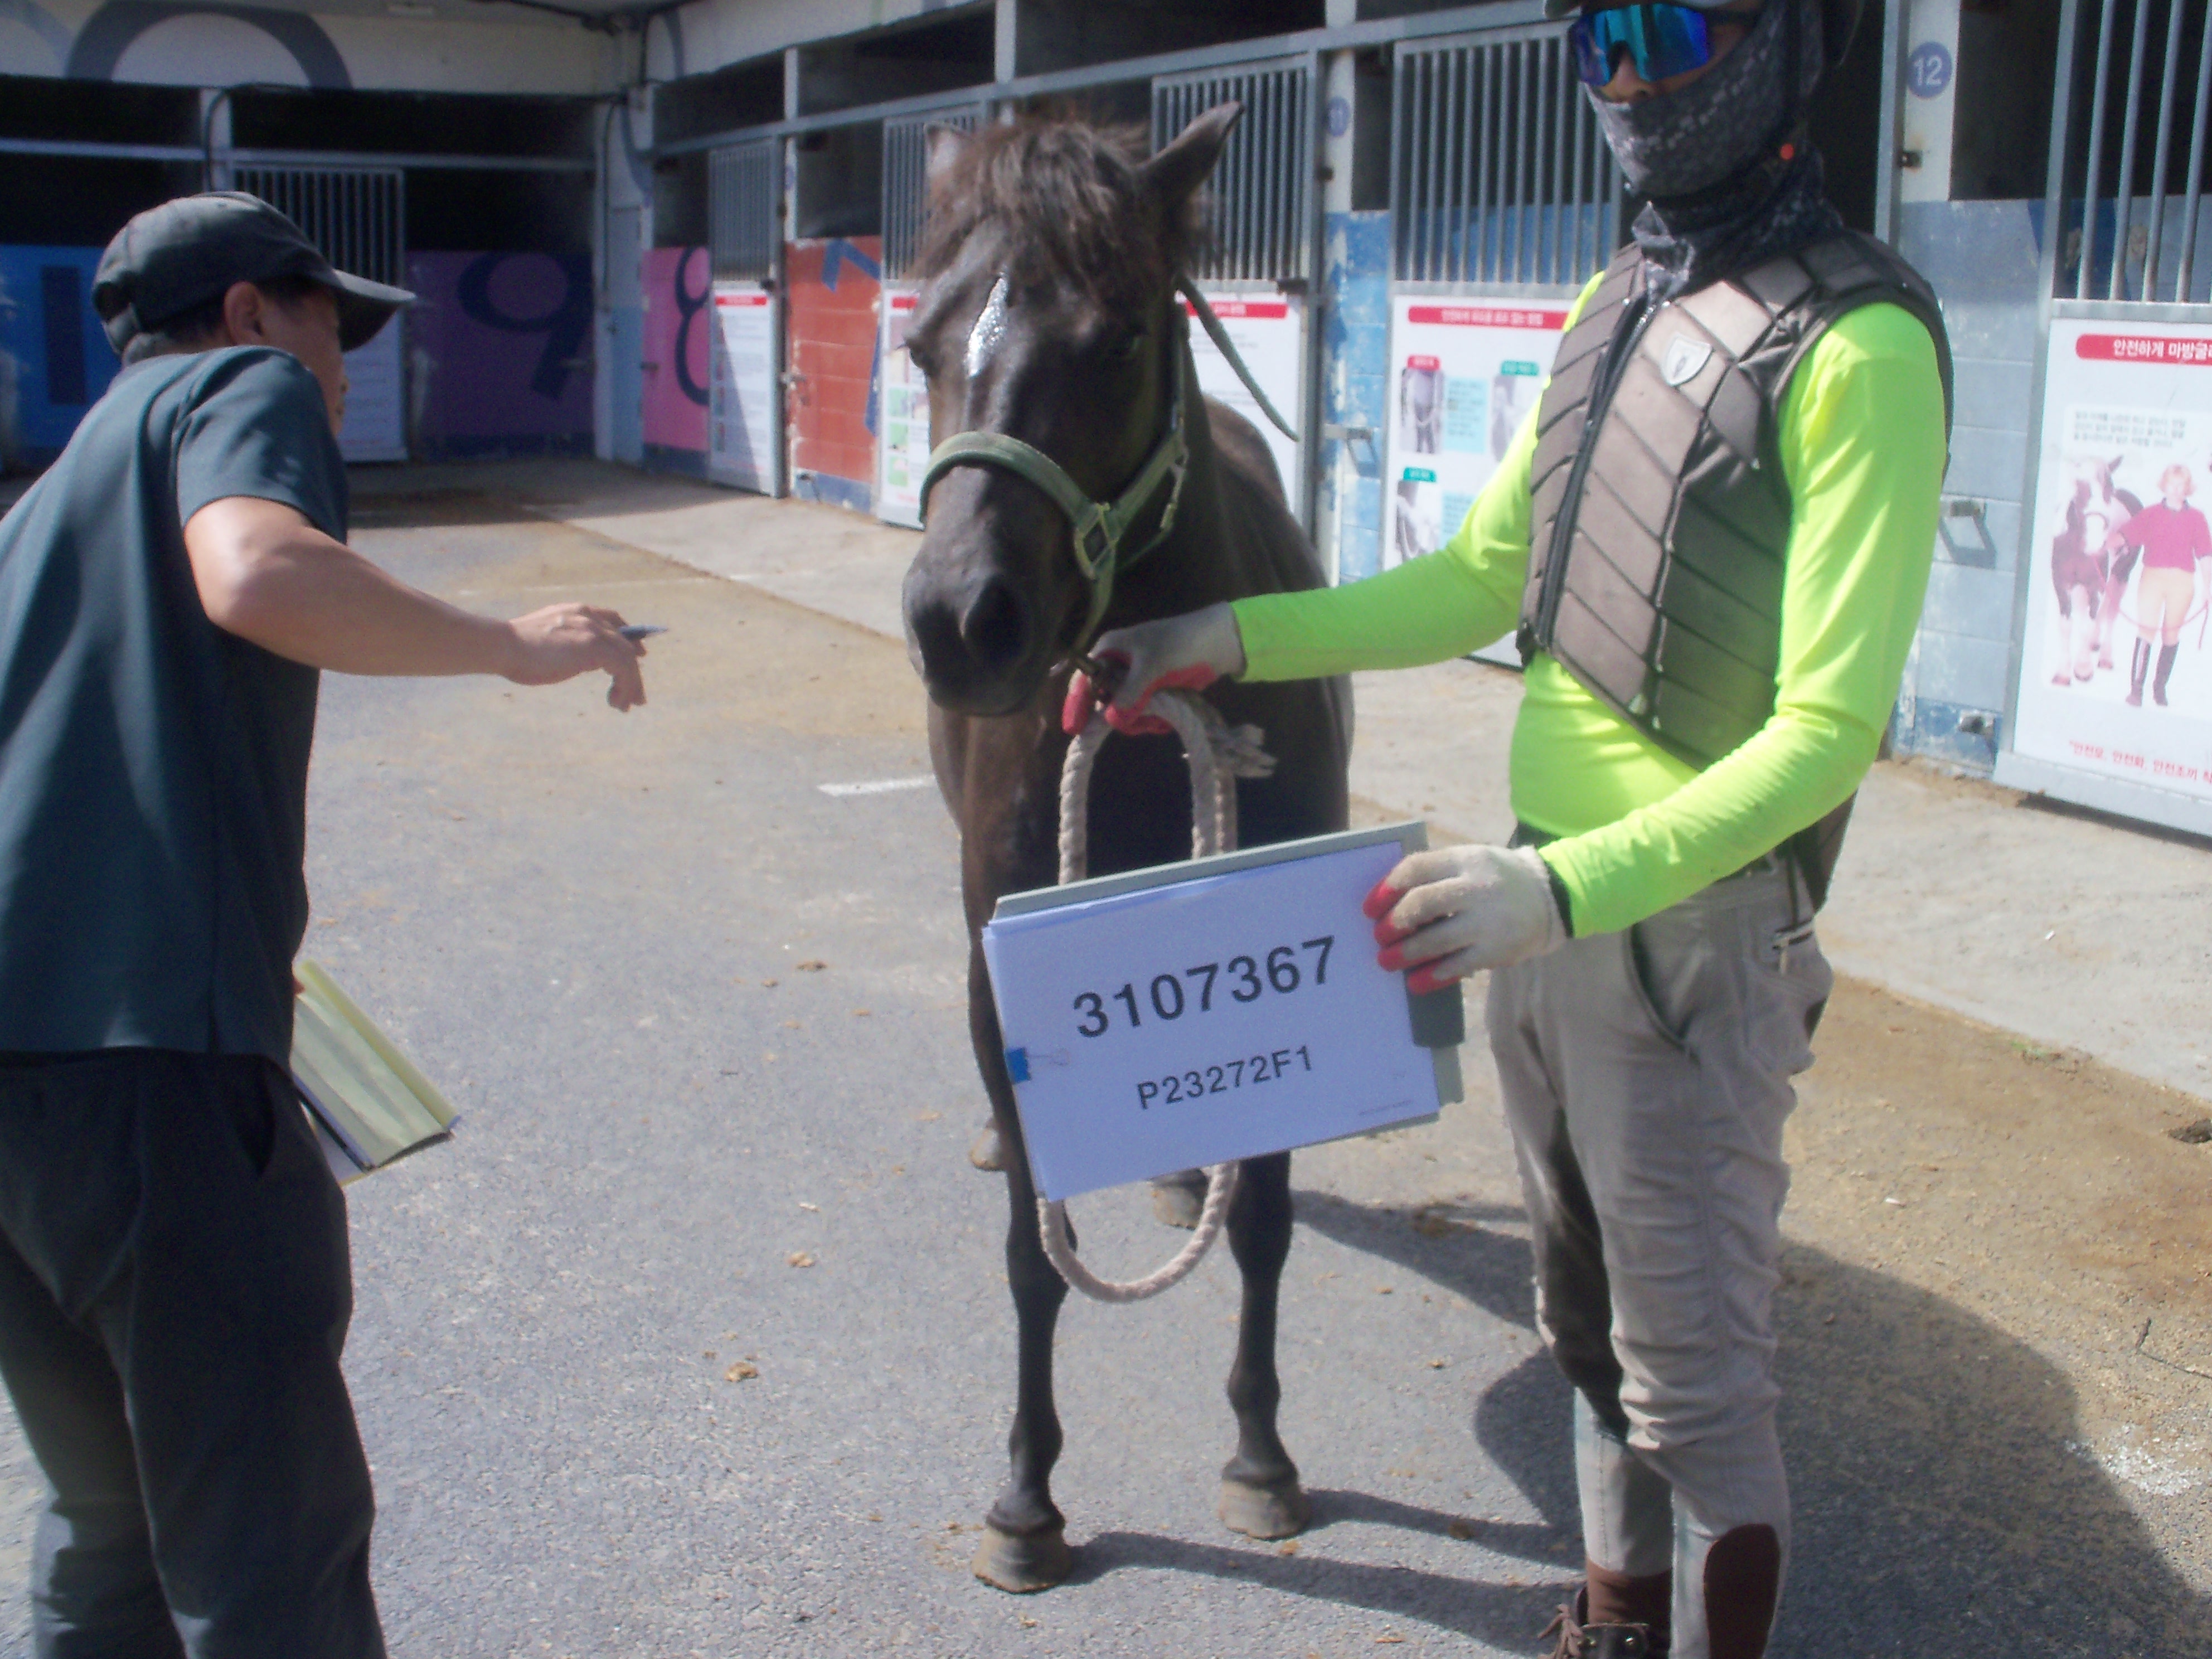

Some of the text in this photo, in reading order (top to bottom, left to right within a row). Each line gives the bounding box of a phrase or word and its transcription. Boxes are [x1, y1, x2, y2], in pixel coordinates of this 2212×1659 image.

[1914, 55, 1943, 86] 12
[458, 250, 593, 401] 9
[2113, 338, 2164, 358] 안전하게
[1073, 935, 1335, 1037] 3107367
[1137, 1045, 1312, 1110] P23272F1
